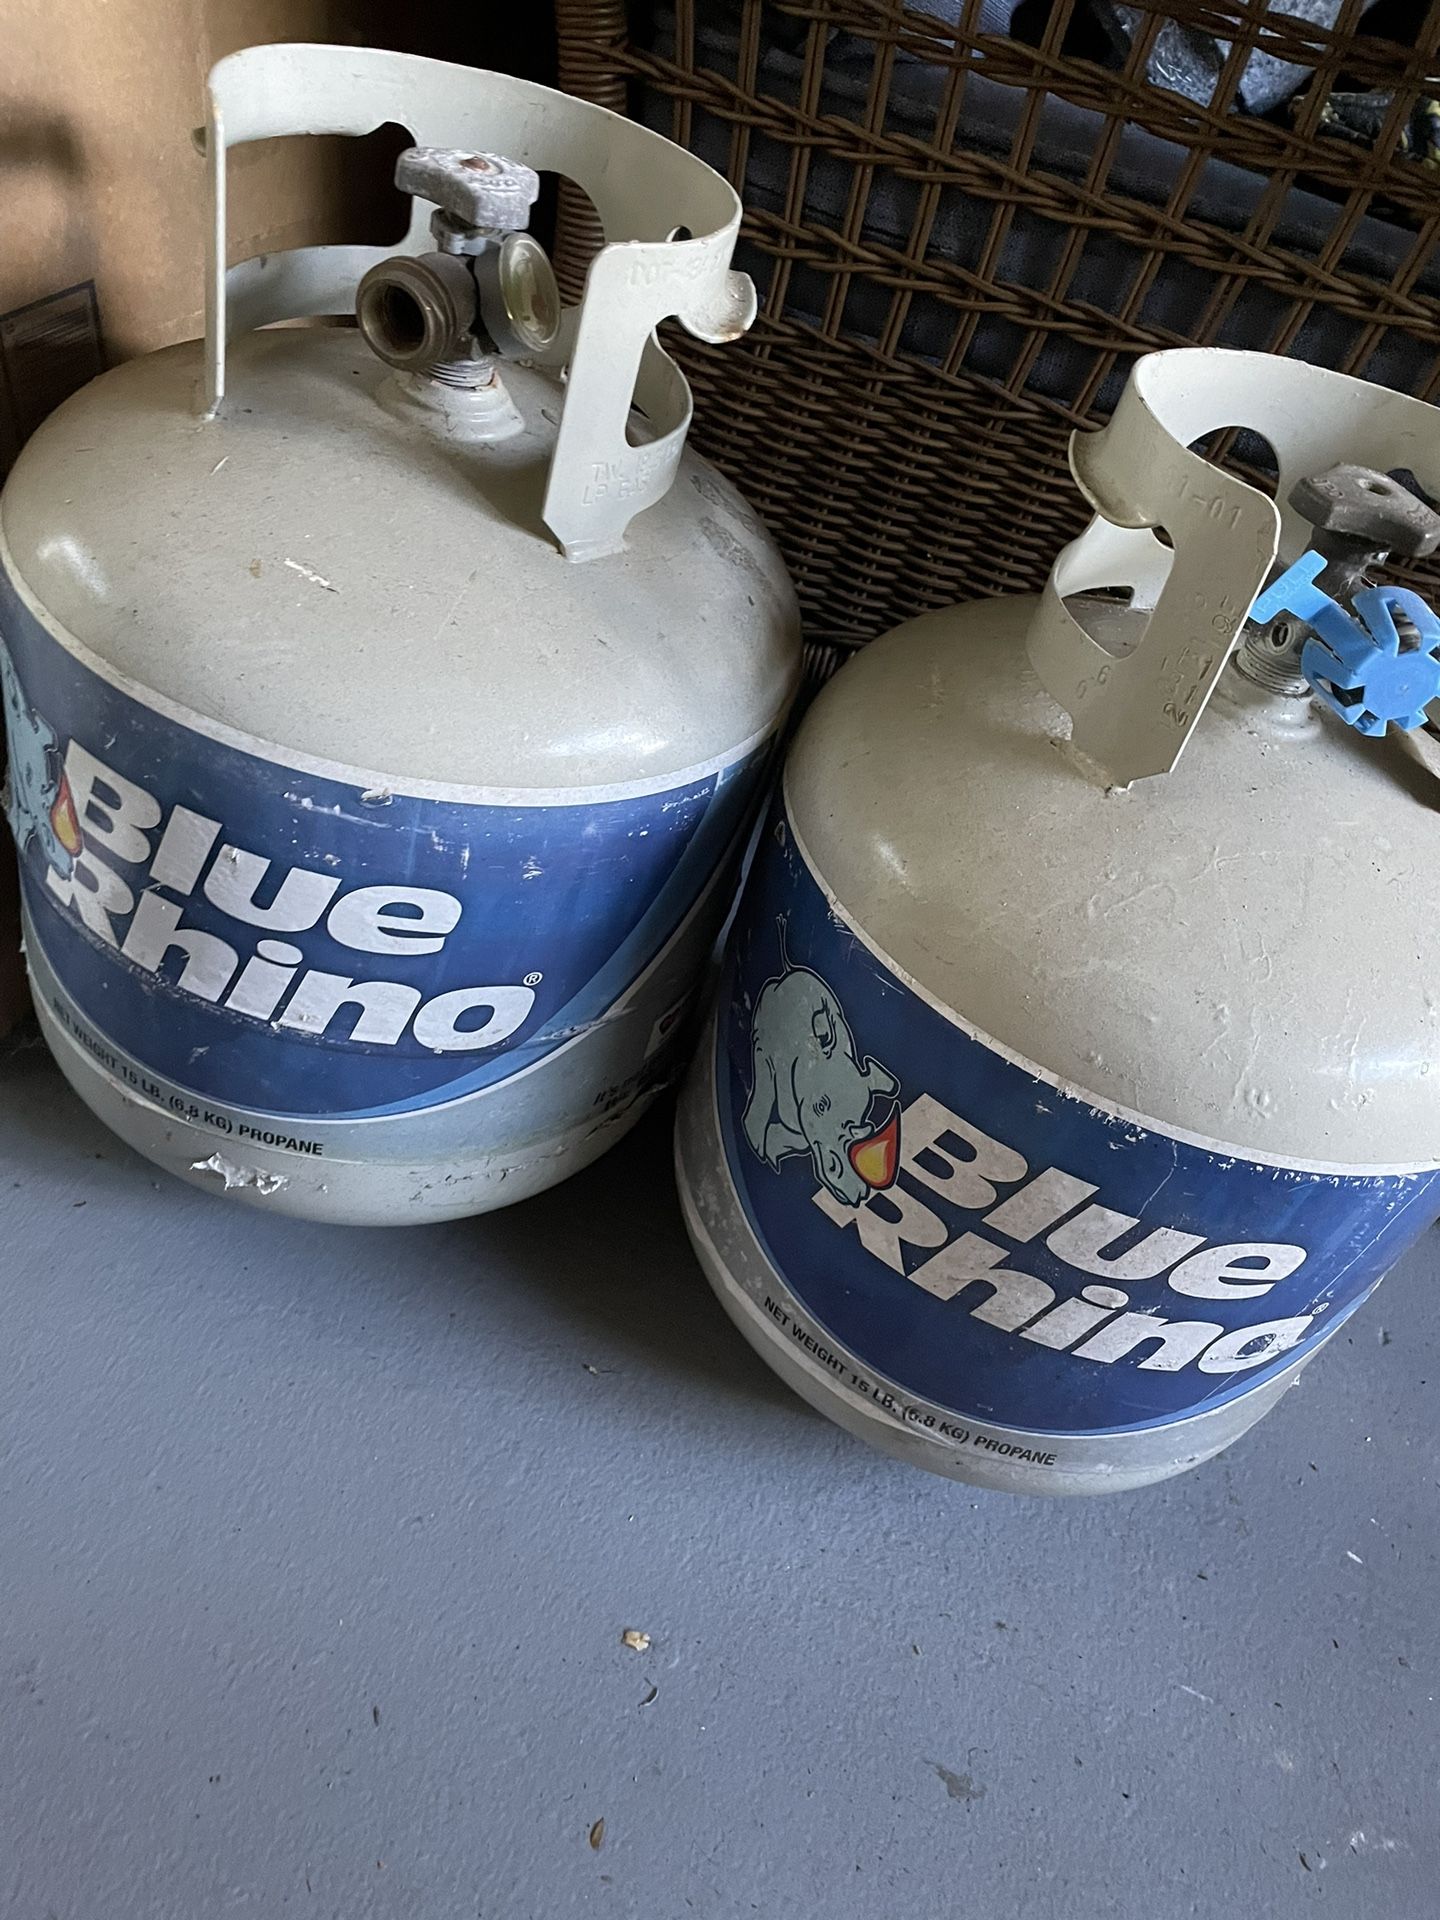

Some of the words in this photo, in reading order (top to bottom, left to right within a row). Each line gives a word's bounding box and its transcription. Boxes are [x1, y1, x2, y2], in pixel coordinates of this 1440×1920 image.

[64, 739, 463, 955] Blue
[73, 1021, 117, 1069] WEIGHT
[121, 1065, 138, 1085] 15
[142, 1079, 165, 1102] LB.
[204, 1111, 233, 1134] KG)
[239, 1124, 325, 1156] PROPANE
[898, 1092, 1307, 1299] Blue
[764, 1296, 791, 1326] NET
[792, 1324, 849, 1375] WEIGHT
[851, 1374, 871, 1393] 15
[872, 1387, 898, 1413] LB.
[902, 1404, 937, 1428] (6.8
[939, 1421, 970, 1444] KG)
[973, 1435, 1059, 1467] PROPANE
